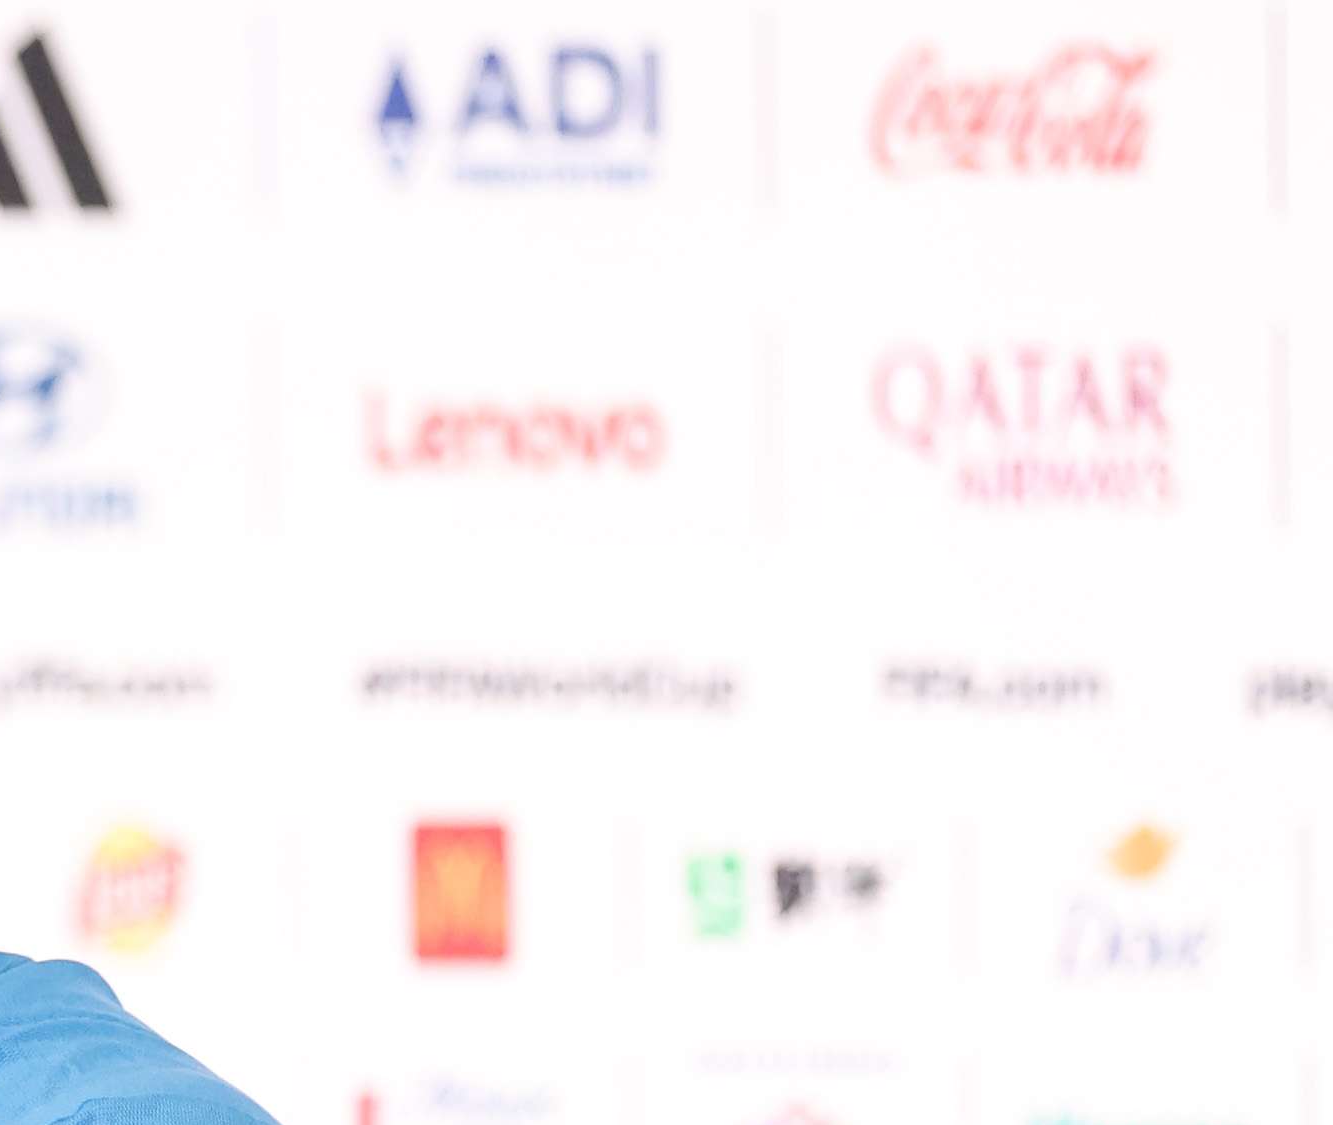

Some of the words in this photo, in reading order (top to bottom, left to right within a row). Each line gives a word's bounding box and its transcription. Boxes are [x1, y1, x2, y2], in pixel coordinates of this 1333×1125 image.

[453, 43, 660, 142] ADI
[366, 398, 666, 473] Lenovo
[870, 343, 1171, 461] QATAR
